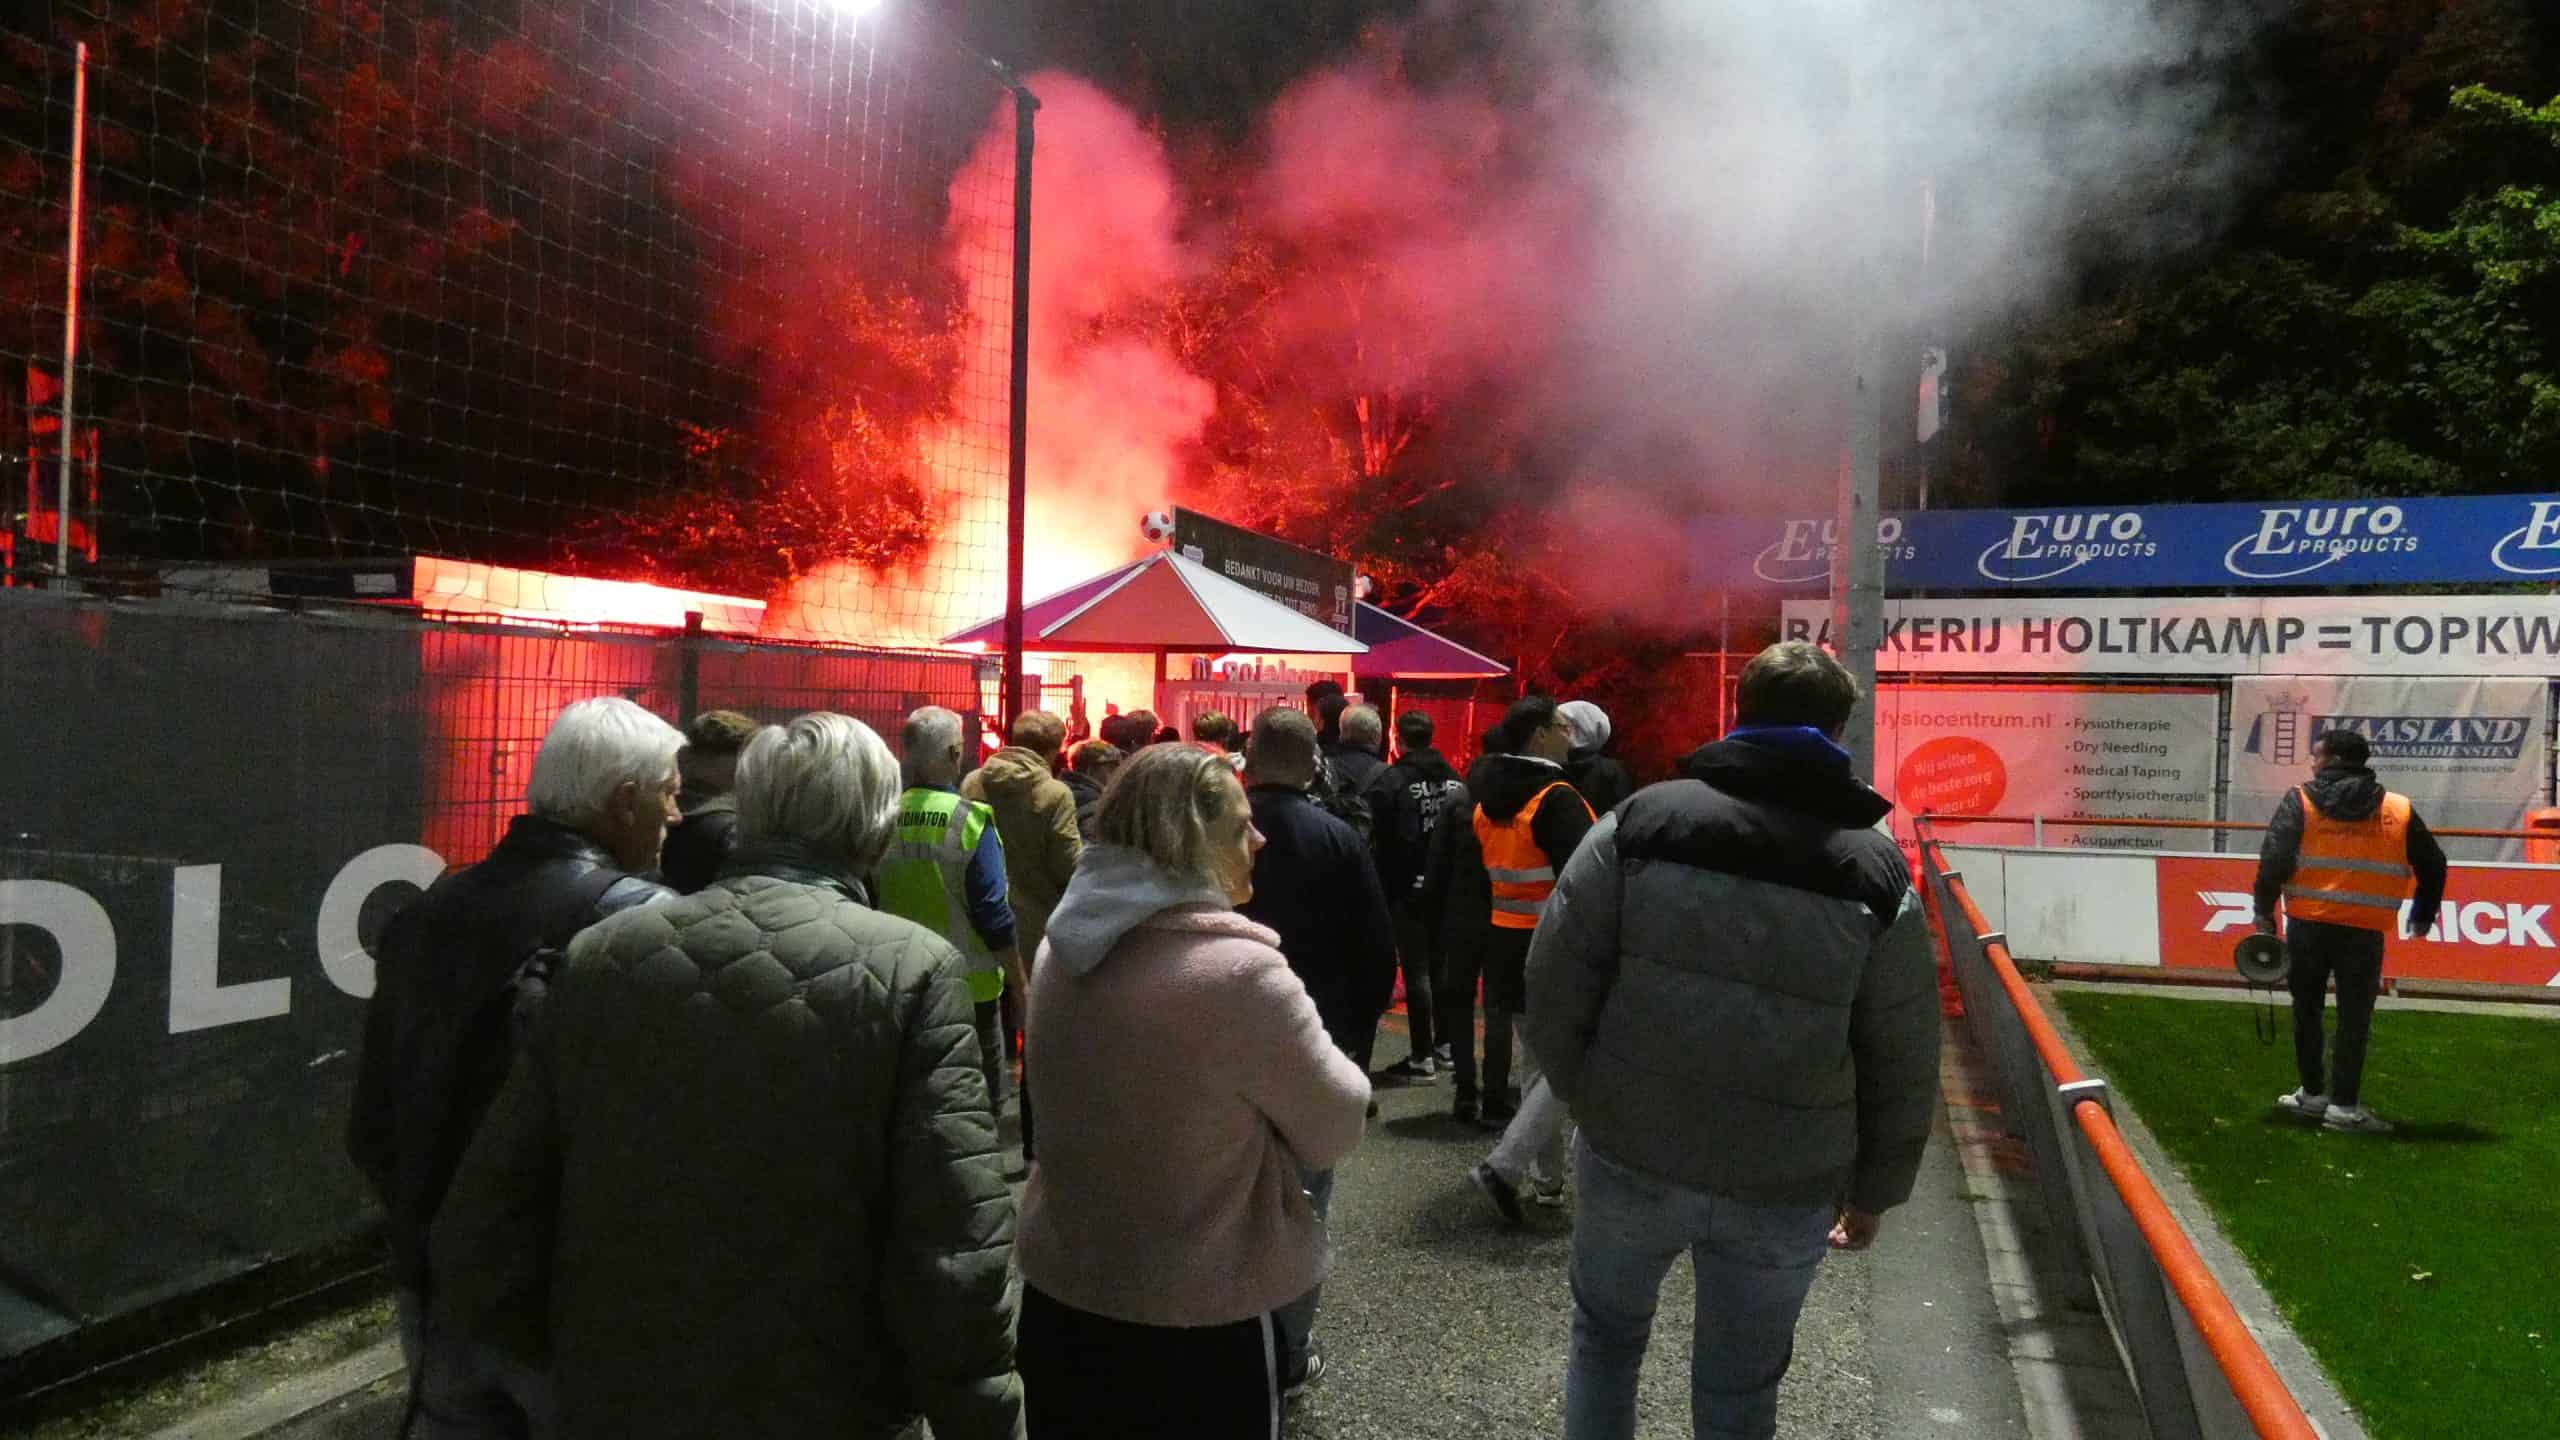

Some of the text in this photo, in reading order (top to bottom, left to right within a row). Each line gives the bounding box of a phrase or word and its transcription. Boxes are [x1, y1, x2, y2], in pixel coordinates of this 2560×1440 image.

[2002, 511, 2142, 560] Euro
[2249, 504, 2403, 555] Euro
[1776, 517, 1902, 562] Euo
[2299, 536, 2417, 554] PRODUCTS
[2047, 541, 2157, 558] PRODUCTS
[1225, 559, 1260, 580] BEDANKT
[1263, 568, 1282, 586] VOOR
[2022, 616, 2305, 654] HOLTKAMP
[2073, 717, 2171, 732] Fysiotherapie
[2073, 740, 2168, 757] Dry Needling
[2072, 765, 2182, 781] Medical Taping
[2073, 787, 2206, 803] Sportfysiotherapie
[2071, 833, 2164, 848] Acupunctuur
